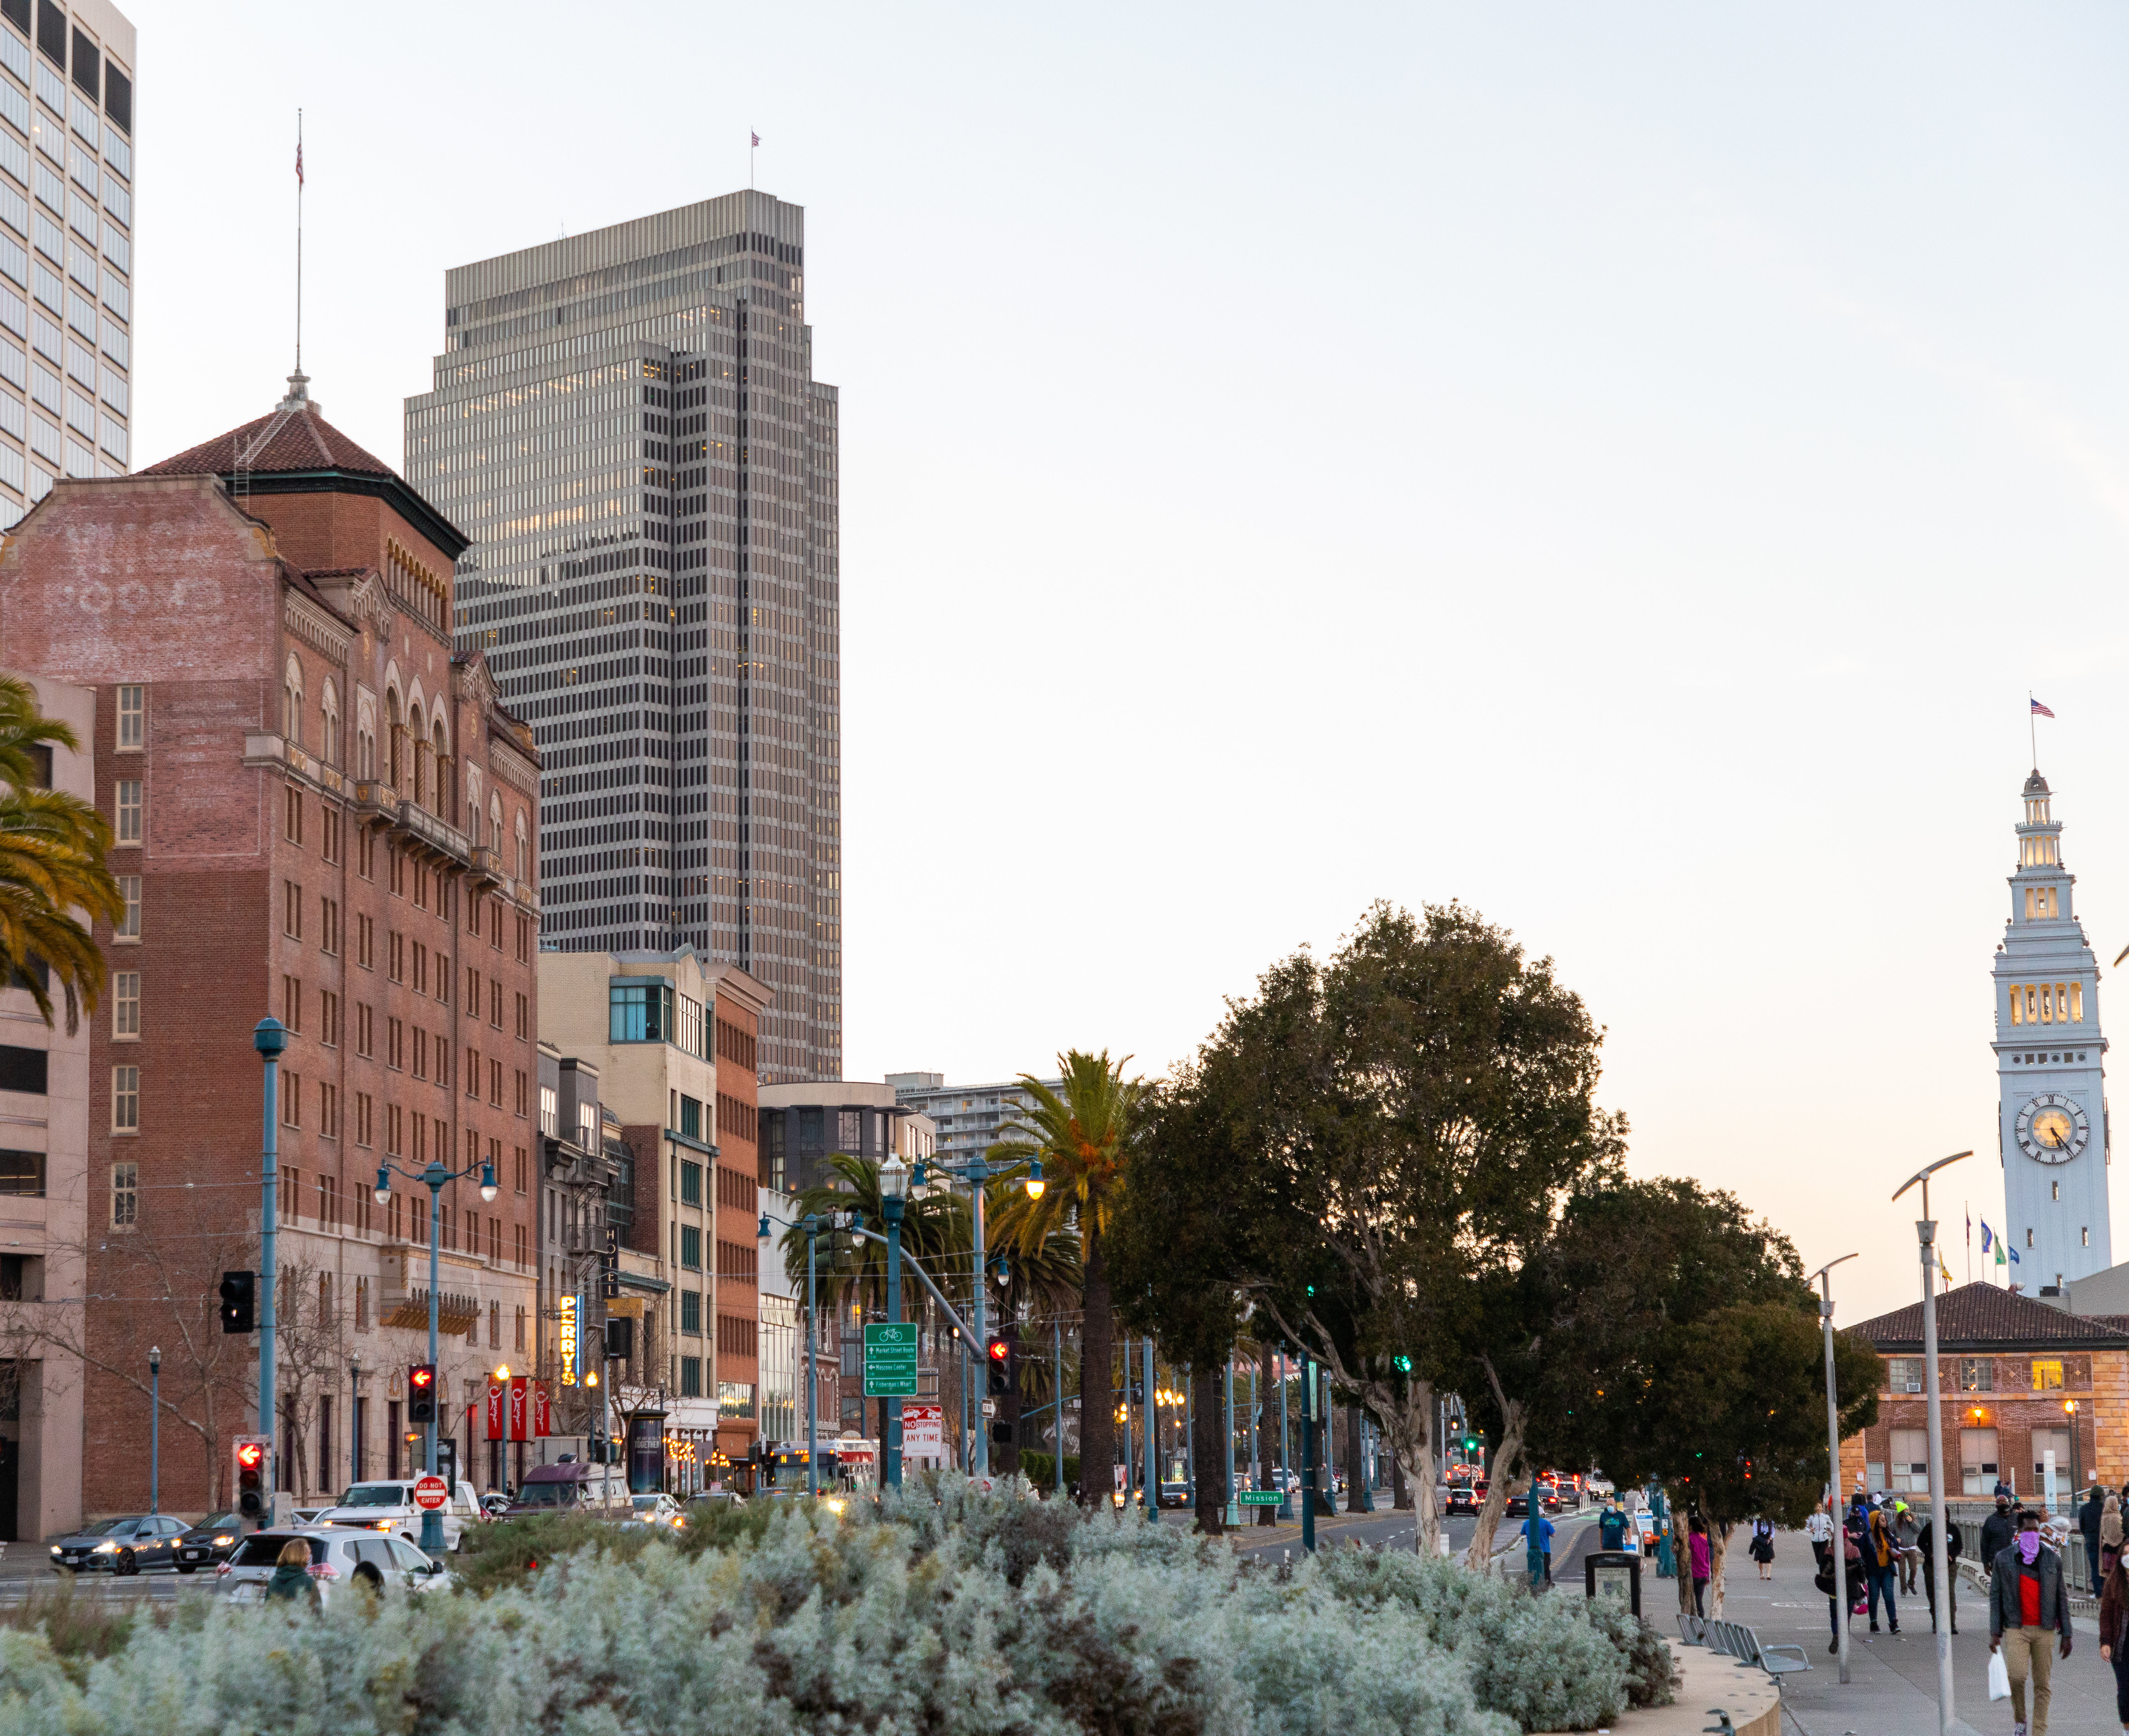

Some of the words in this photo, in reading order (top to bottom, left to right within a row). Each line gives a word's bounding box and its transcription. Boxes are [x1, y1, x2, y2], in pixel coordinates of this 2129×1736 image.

[607, 1230, 615, 1295] HOTEL
[560, 1296, 576, 1386] PERRY'S
[781, 1455, 787, 1463] N
